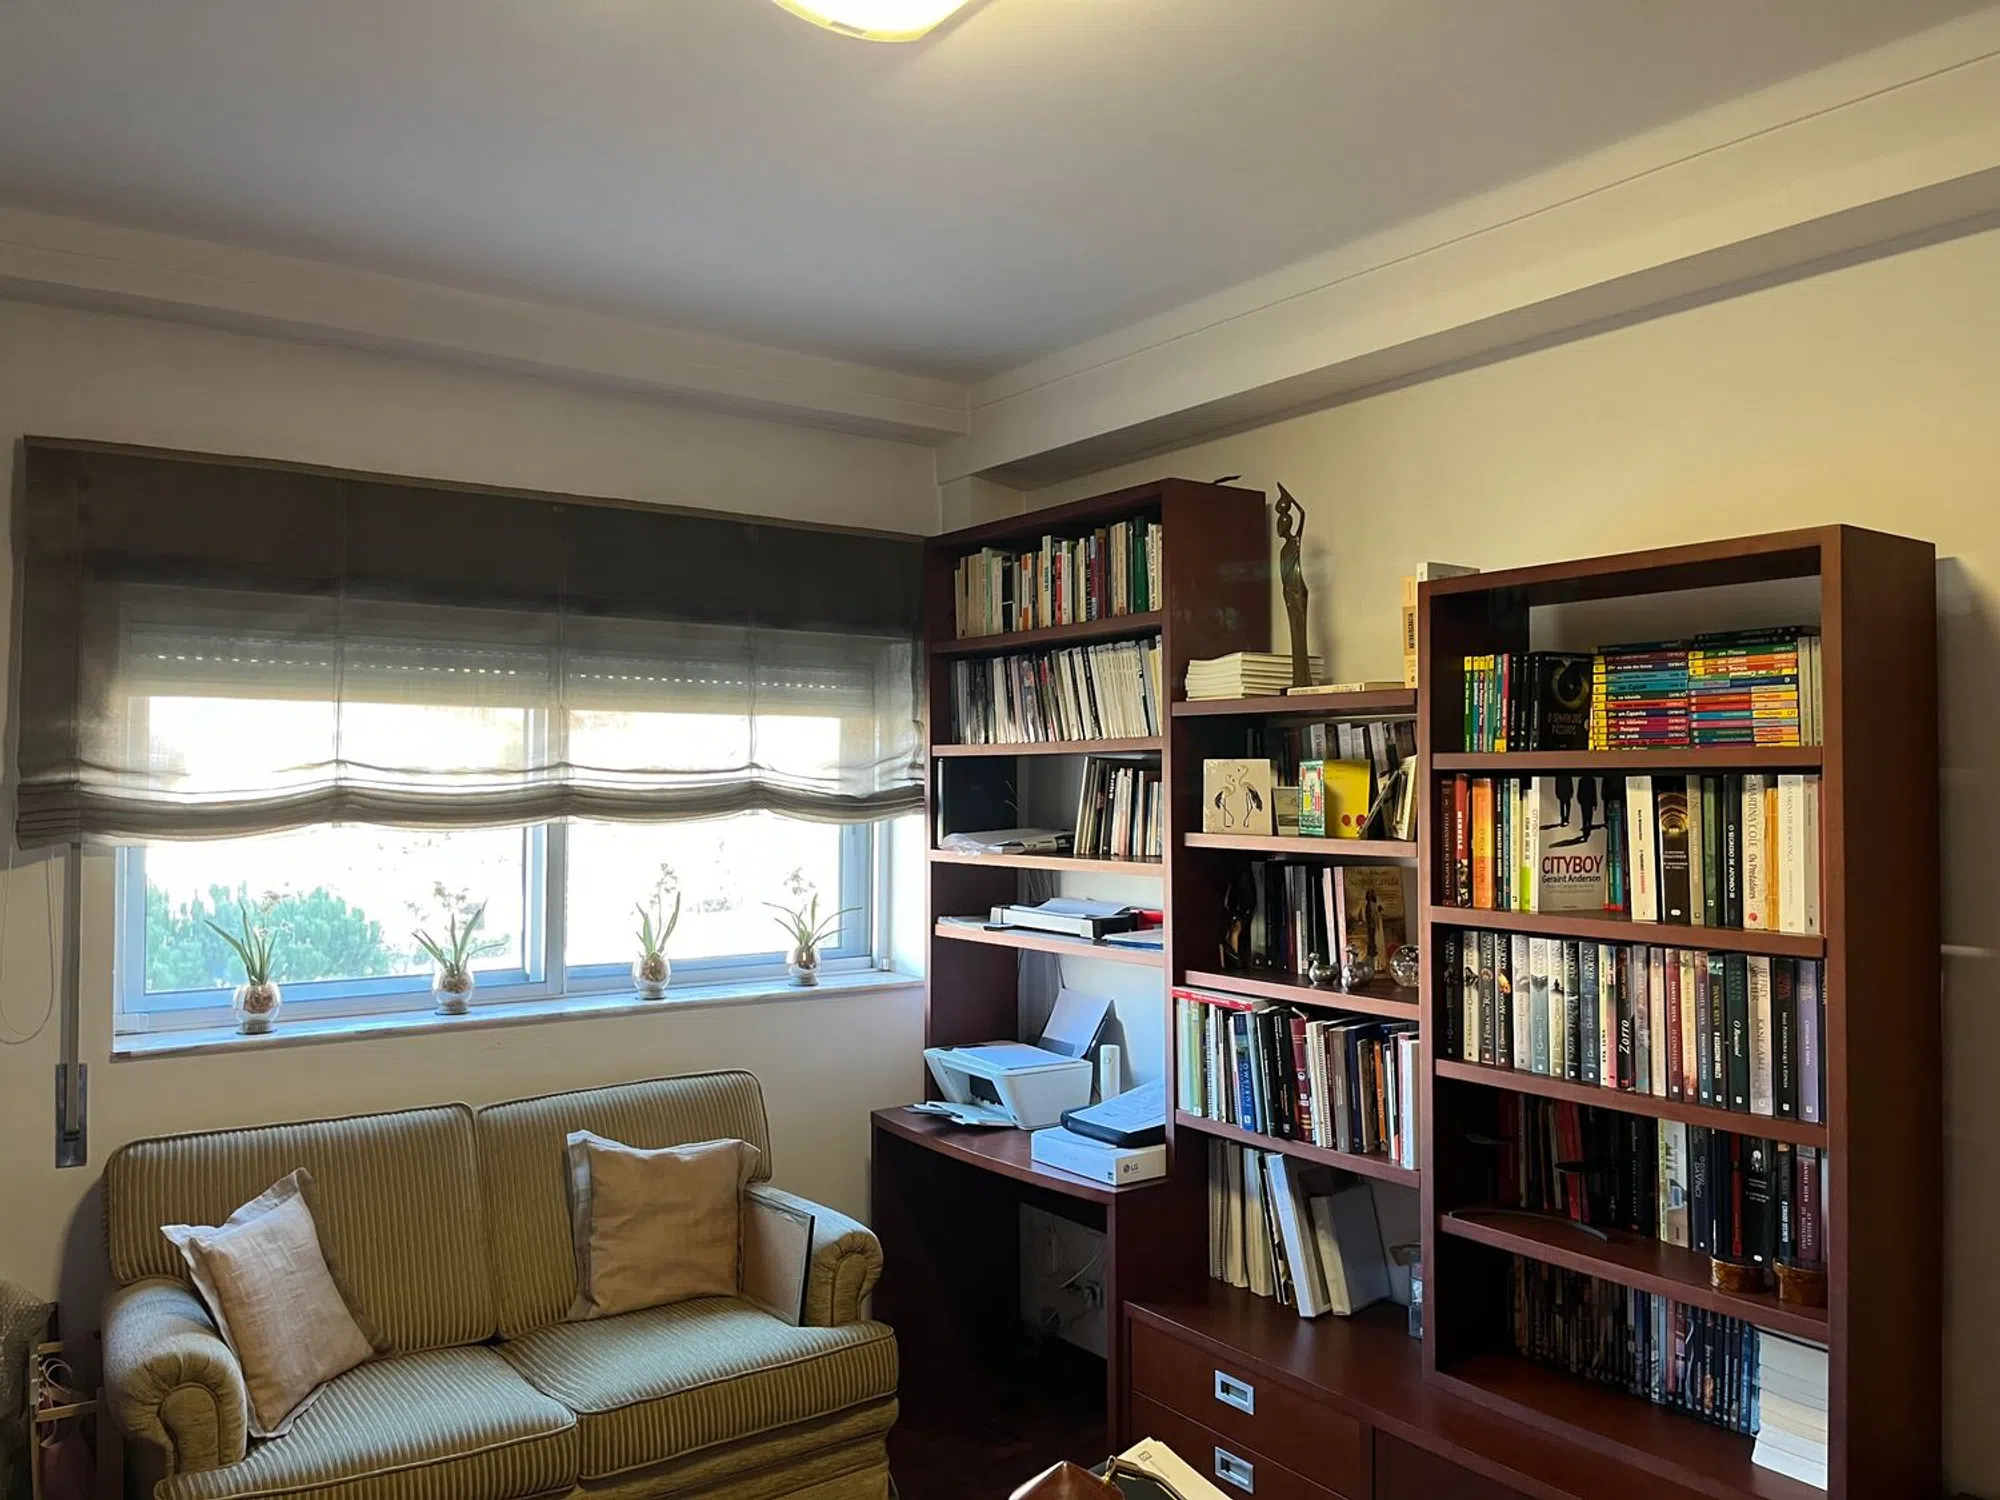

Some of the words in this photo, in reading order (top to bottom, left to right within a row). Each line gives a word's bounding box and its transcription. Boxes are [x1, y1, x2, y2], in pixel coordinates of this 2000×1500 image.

[1748, 782, 1758, 822] MARTINA
[1748, 824, 1758, 848] COLE
[1542, 856, 1603, 875] CITYBOY
[1728, 858, 1735, 866] DE
[1749, 853, 1757, 863] Os
[1542, 874, 1567, 884] Geraint
[1568, 874, 1601, 883] Anderson
[1748, 864, 1758, 900] Predadores
[1750, 963, 1759, 1002] ARCHER
[1759, 966, 1768, 999] JEFFREY
[1733, 1020, 1740, 1028] O
[1618, 1019, 1630, 1055] Zorro
[1242, 1062, 1252, 1107] TURISMO
[1130, 1163, 1139, 1172] LG
[1694, 1172, 1704, 1198] VINCI
